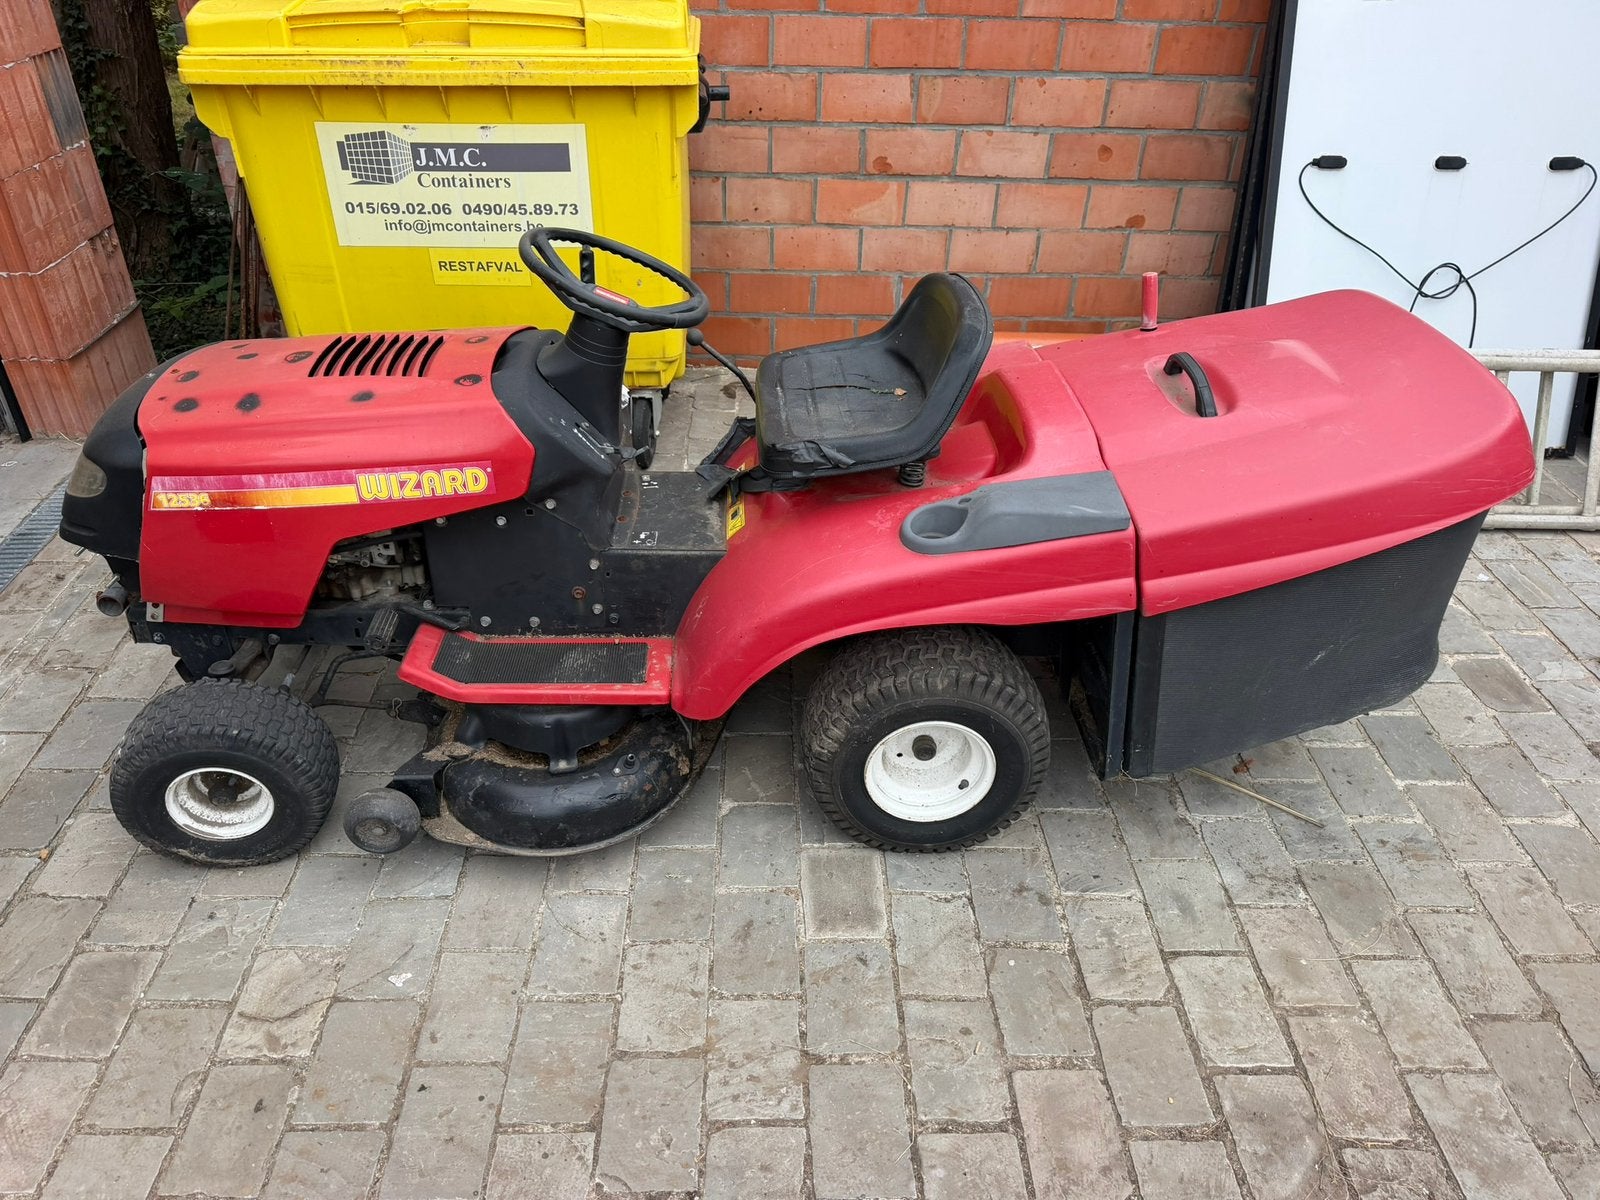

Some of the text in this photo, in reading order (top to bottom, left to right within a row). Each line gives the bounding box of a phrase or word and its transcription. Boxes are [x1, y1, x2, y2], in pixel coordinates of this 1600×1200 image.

[415, 147, 487, 167] J.M.C.
[417, 172, 511, 189] Containers
[344, 201, 579, 216] 015/69.02.06 0490/45.89.73
[438, 260, 523, 273] RESTAFVAL
[357, 467, 488, 500] WIZARD
